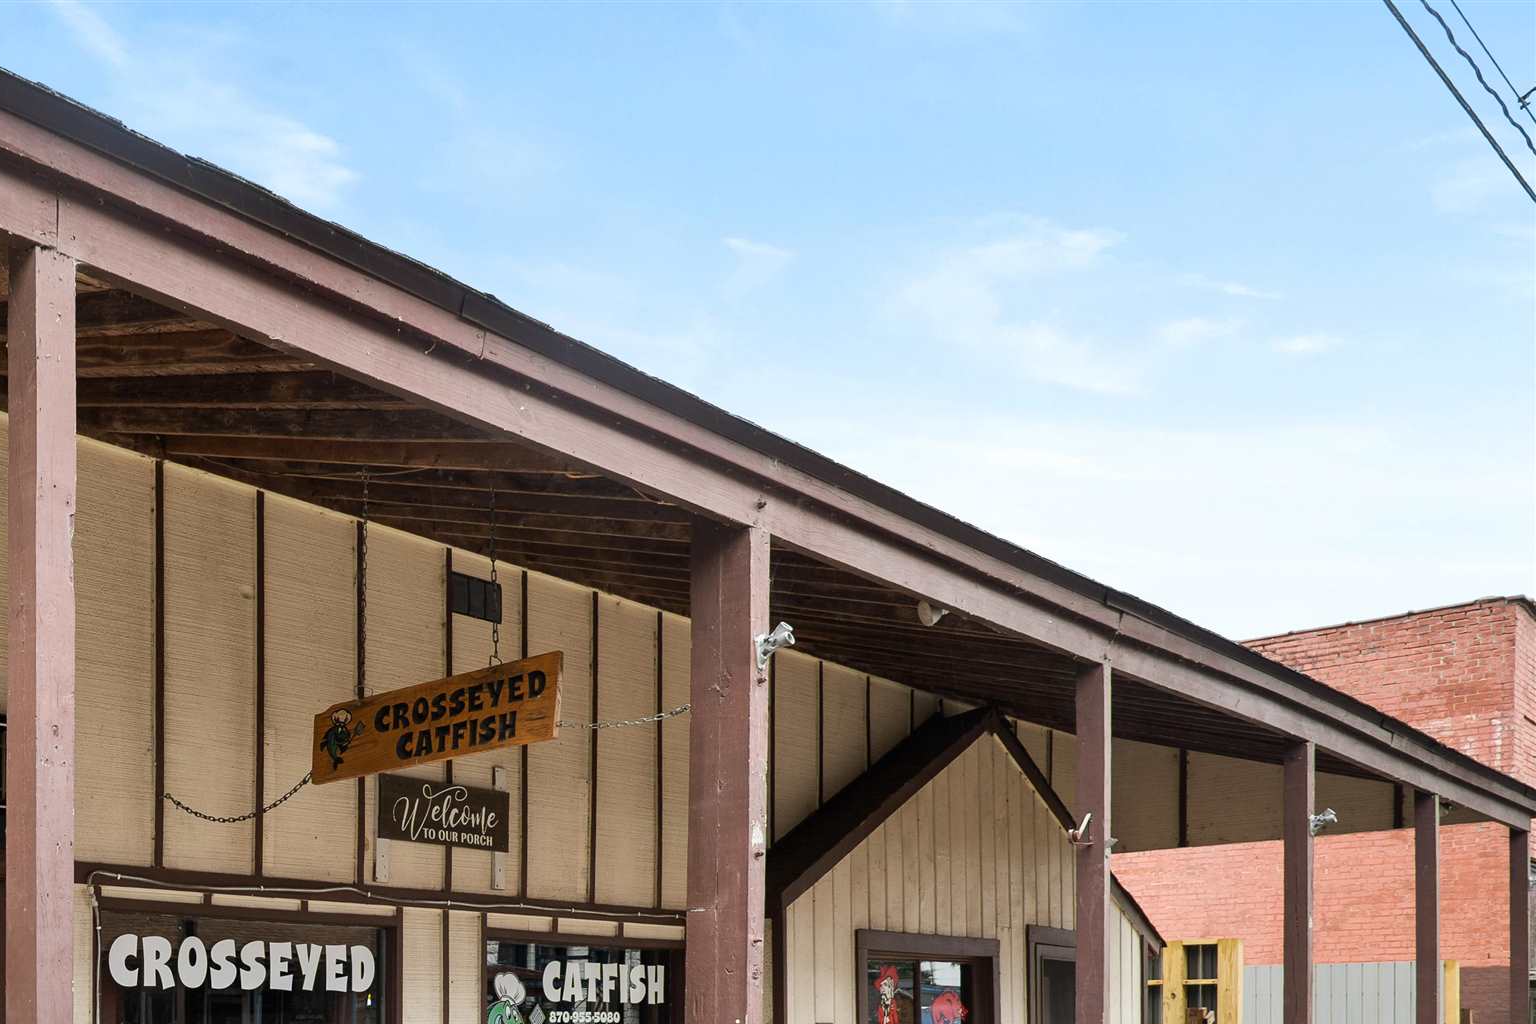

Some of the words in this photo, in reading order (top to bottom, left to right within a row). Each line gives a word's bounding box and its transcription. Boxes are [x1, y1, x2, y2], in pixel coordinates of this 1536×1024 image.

[374, 670, 547, 733] CROSSEYED
[395, 710, 517, 760] CATFISH
[392, 784, 499, 841] Welcome
[423, 827, 436, 840] TO
[438, 829, 459, 843] OUR
[461, 832, 493, 847] PORCH
[108, 933, 375, 993] CROSSEYED
[542, 960, 665, 1005] CATFISH
[549, 1011, 621, 1024] 870-955-5080
